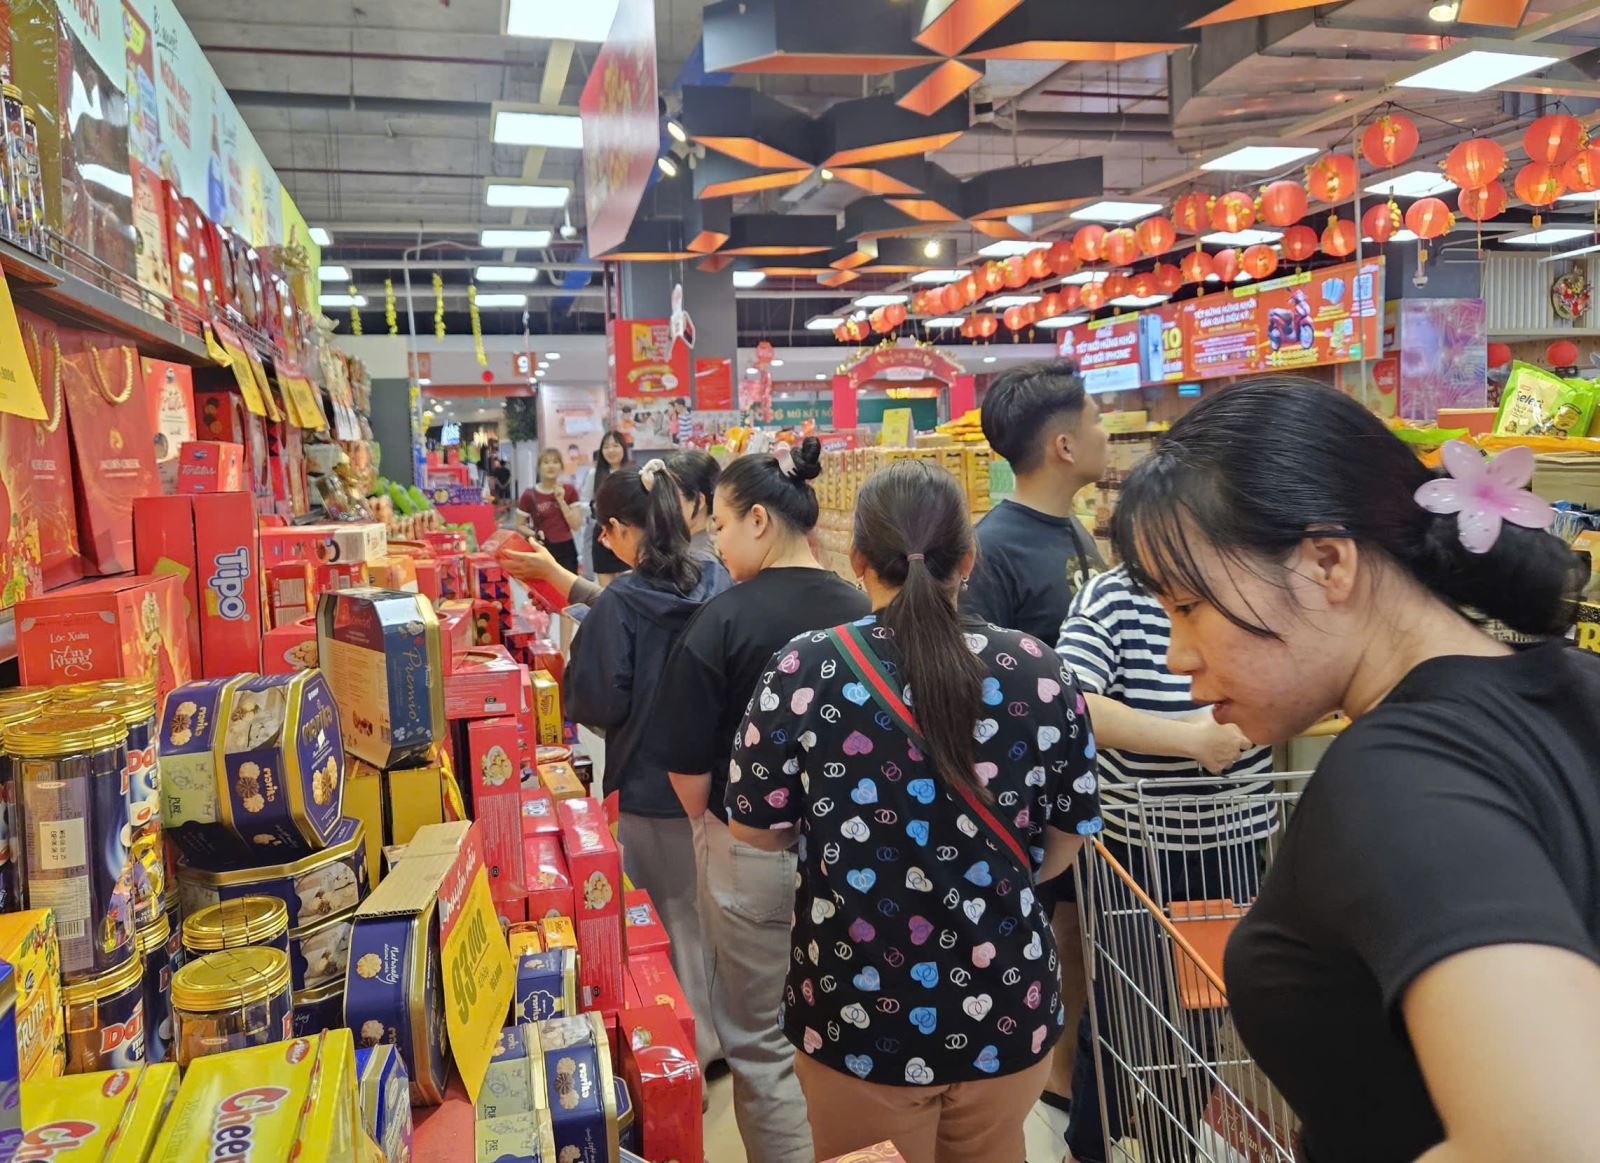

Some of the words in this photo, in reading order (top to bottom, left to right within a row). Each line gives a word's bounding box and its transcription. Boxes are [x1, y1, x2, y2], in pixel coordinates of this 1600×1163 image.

[1162, 327, 1182, 349] 10
[207, 546, 250, 621] Tipo
[402, 647, 423, 720] Premio
[452, 907, 487, 1025] 93.000
